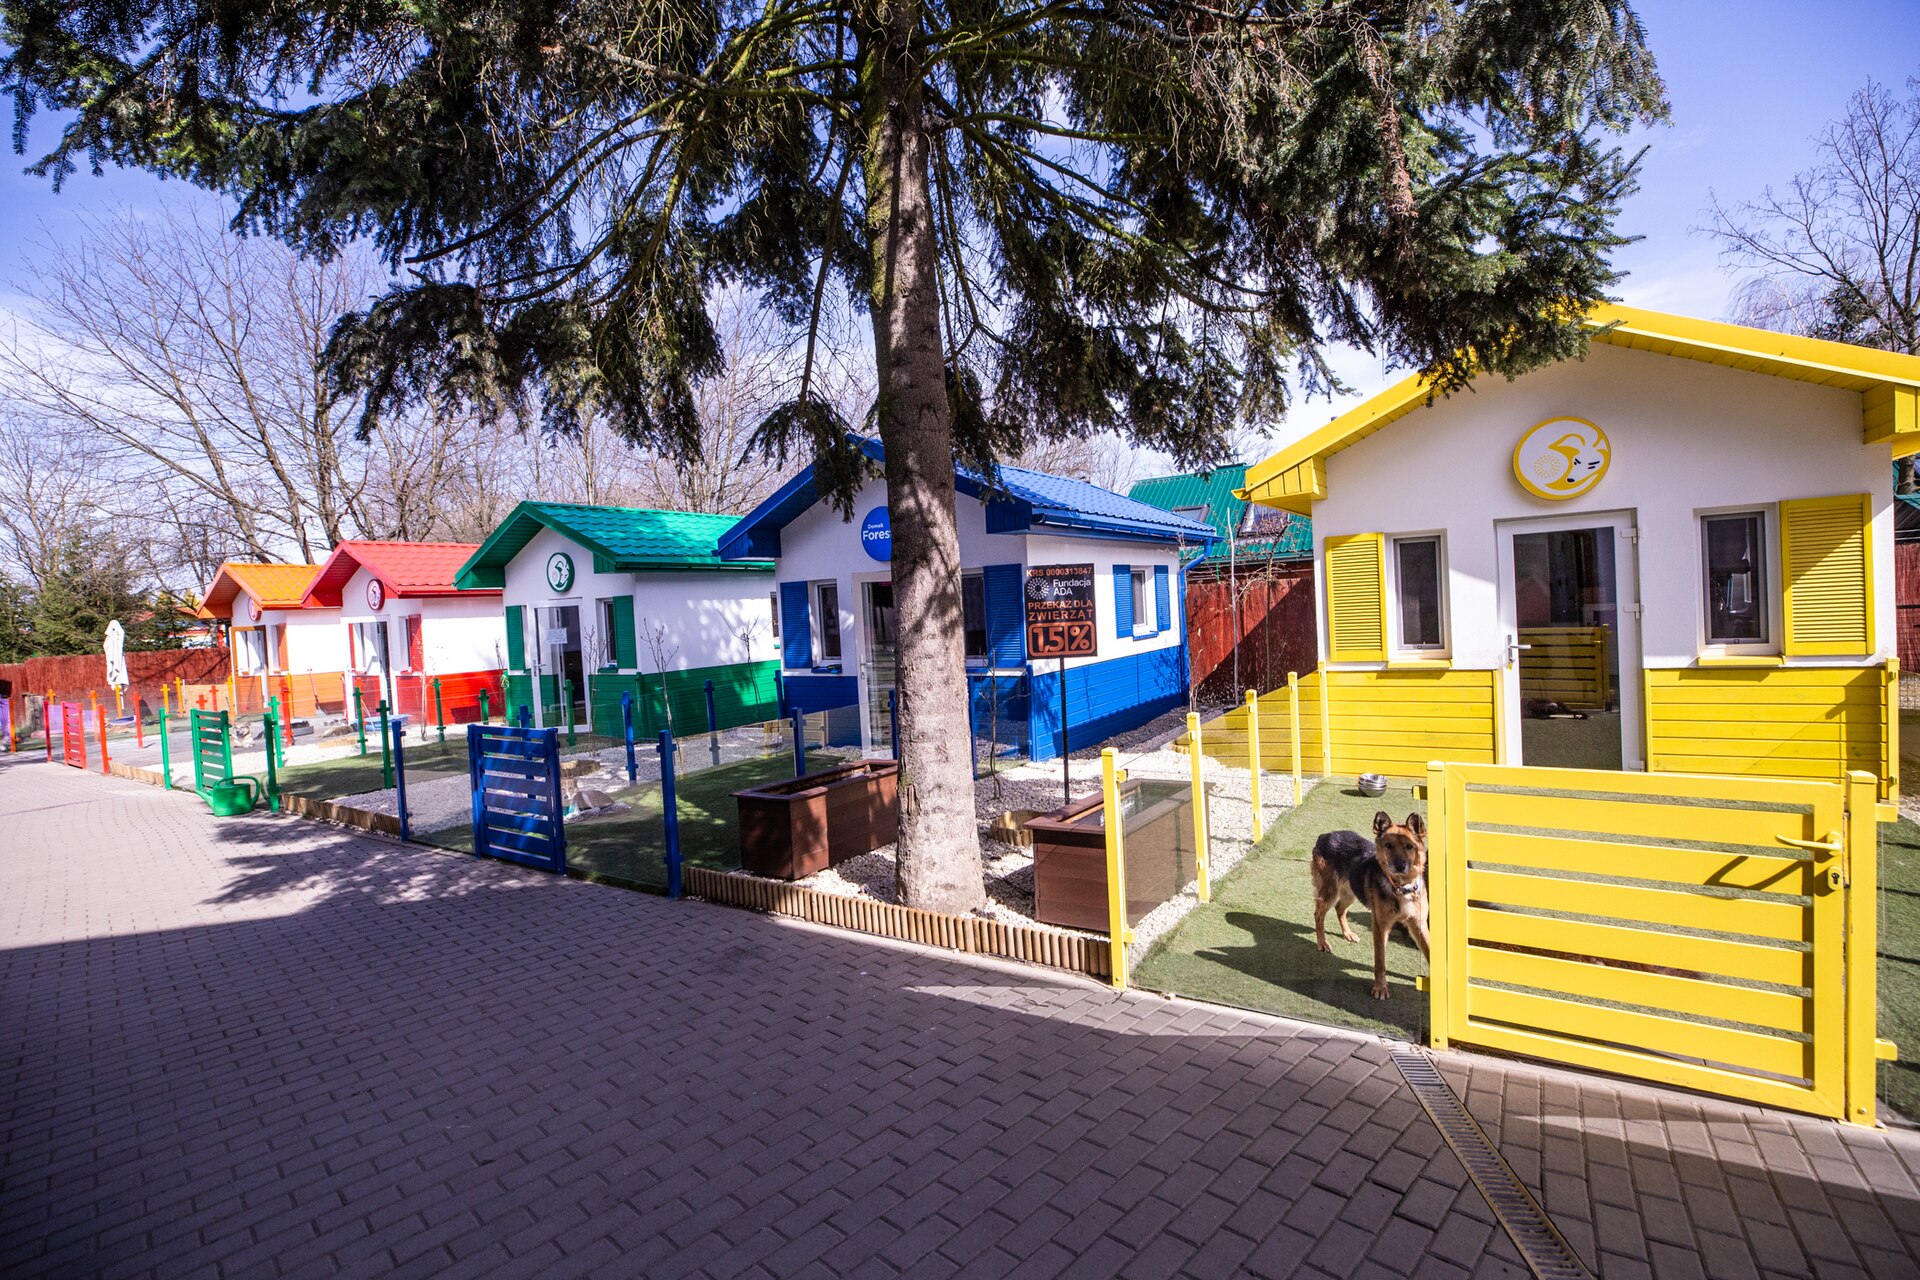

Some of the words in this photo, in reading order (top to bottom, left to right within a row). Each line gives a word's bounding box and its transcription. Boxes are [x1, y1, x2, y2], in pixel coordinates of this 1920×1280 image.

[862, 529, 892, 541] Fores
[1026, 568, 1044, 577] KRS
[1046, 567, 1092, 577] 0000313847
[1052, 578, 1091, 588] Fundacja
[1053, 587, 1073, 596] ADA
[1028, 599, 1072, 610] PRZEKAŻ
[1074, 599, 1093, 608] DLA
[1028, 609, 1094, 621] ZWIERZĄT
